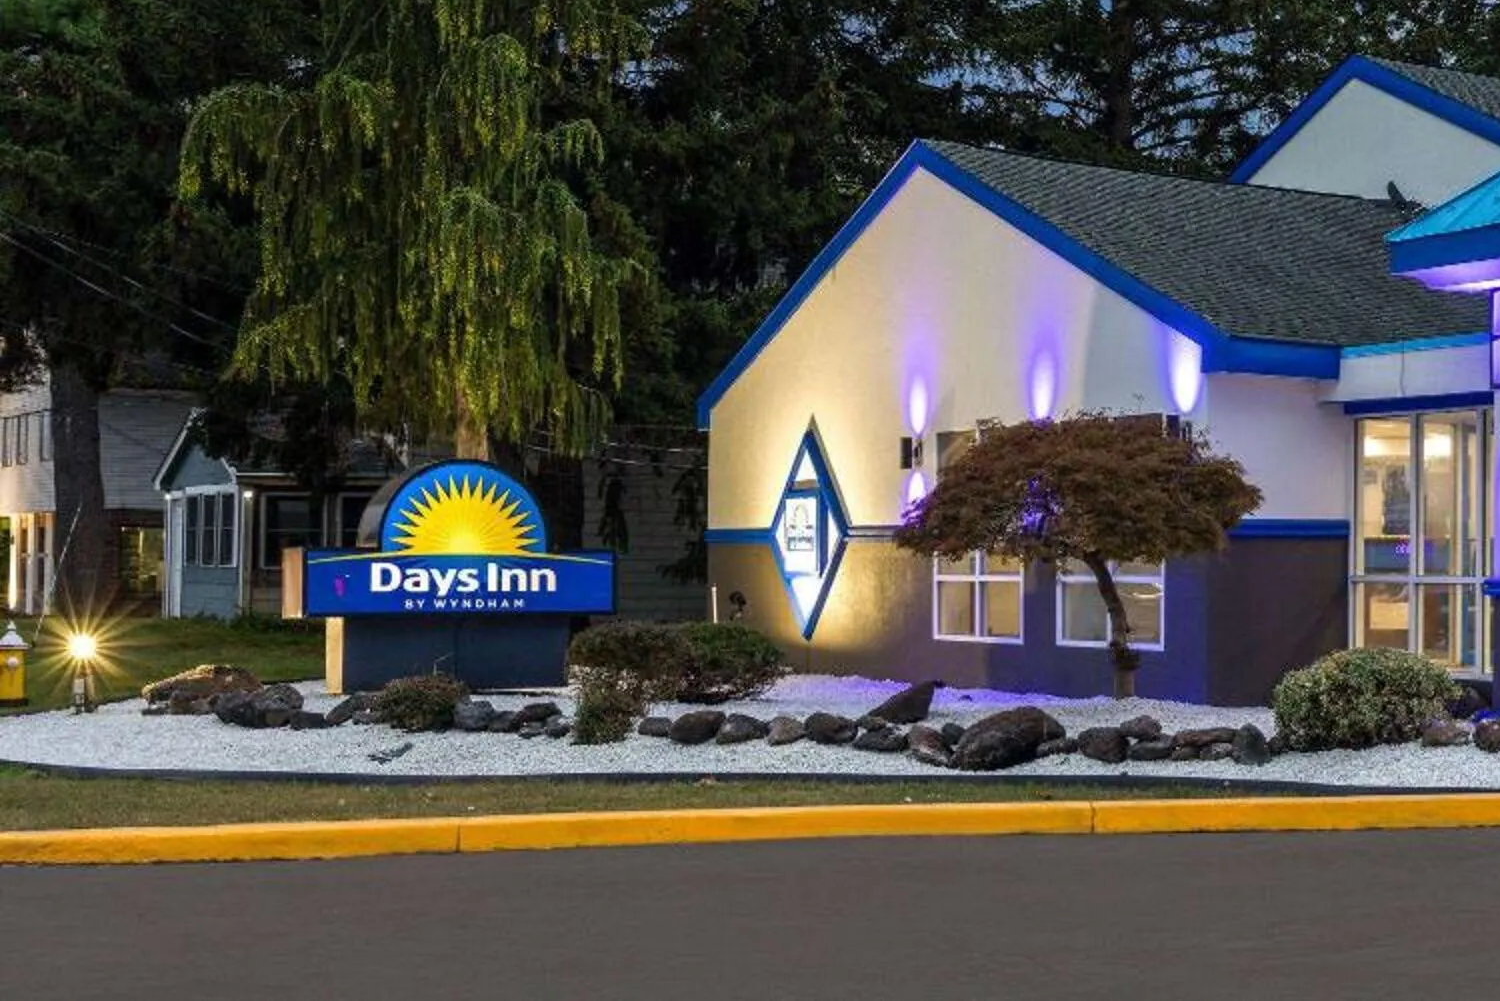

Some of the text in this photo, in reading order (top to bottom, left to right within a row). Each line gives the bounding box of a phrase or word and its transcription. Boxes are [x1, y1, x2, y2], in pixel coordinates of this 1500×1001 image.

[370, 562, 557, 597] Days Inn
[404, 599, 525, 609] BY WYNDHAM
